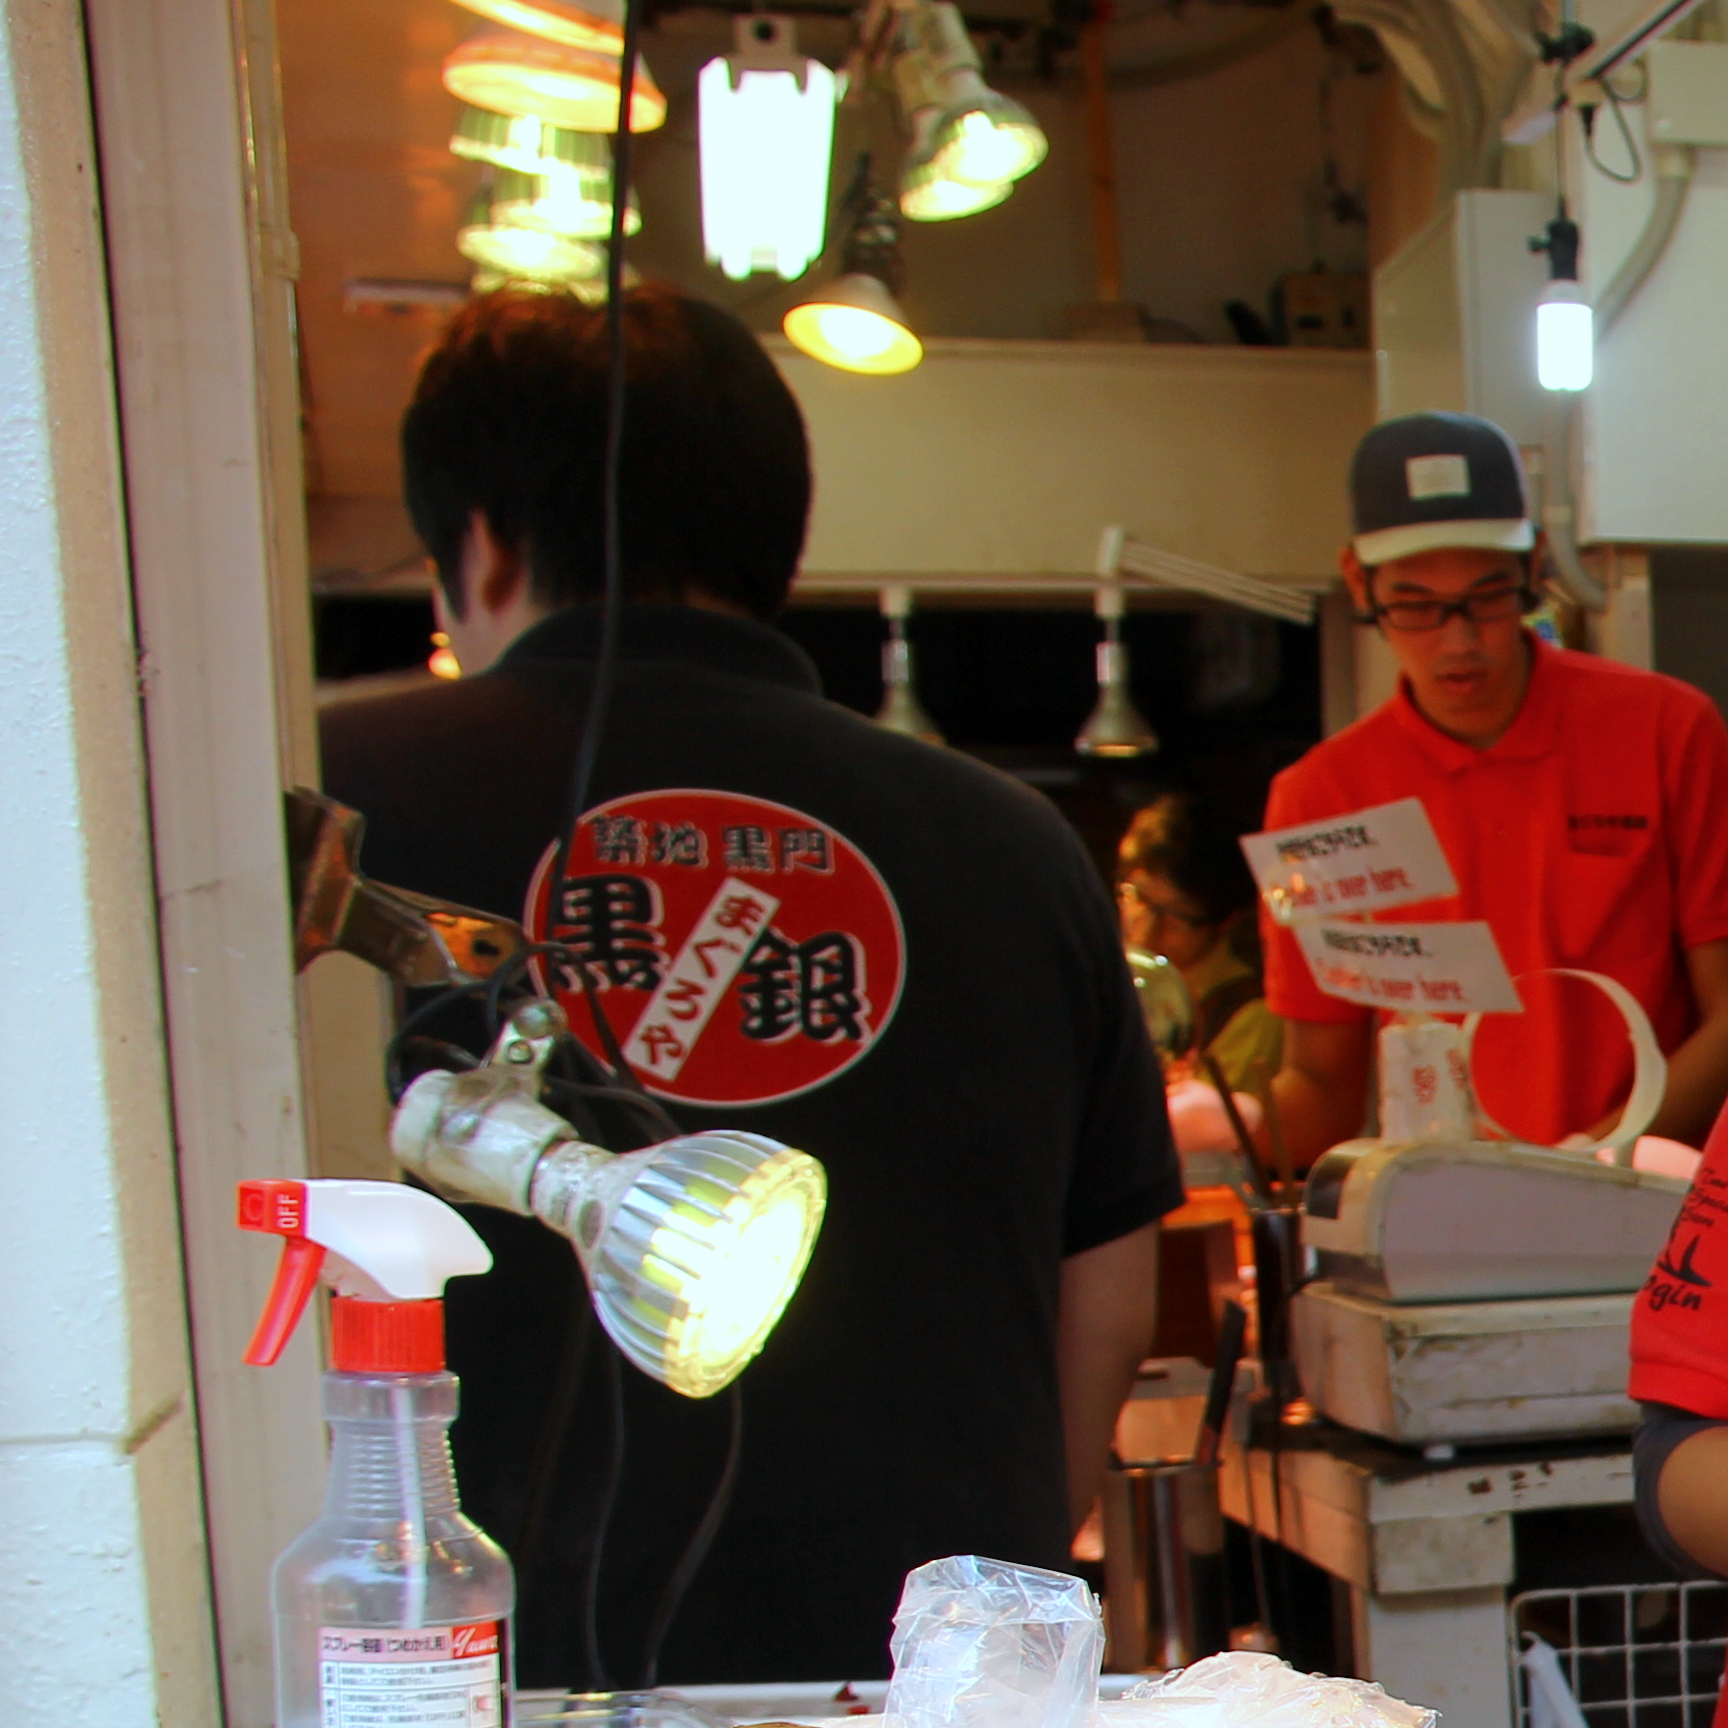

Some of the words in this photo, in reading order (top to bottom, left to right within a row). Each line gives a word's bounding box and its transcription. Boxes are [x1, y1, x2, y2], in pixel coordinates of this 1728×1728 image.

[637, 893, 765, 1066] まぐろや
[276, 1193, 299, 1229] OFF
